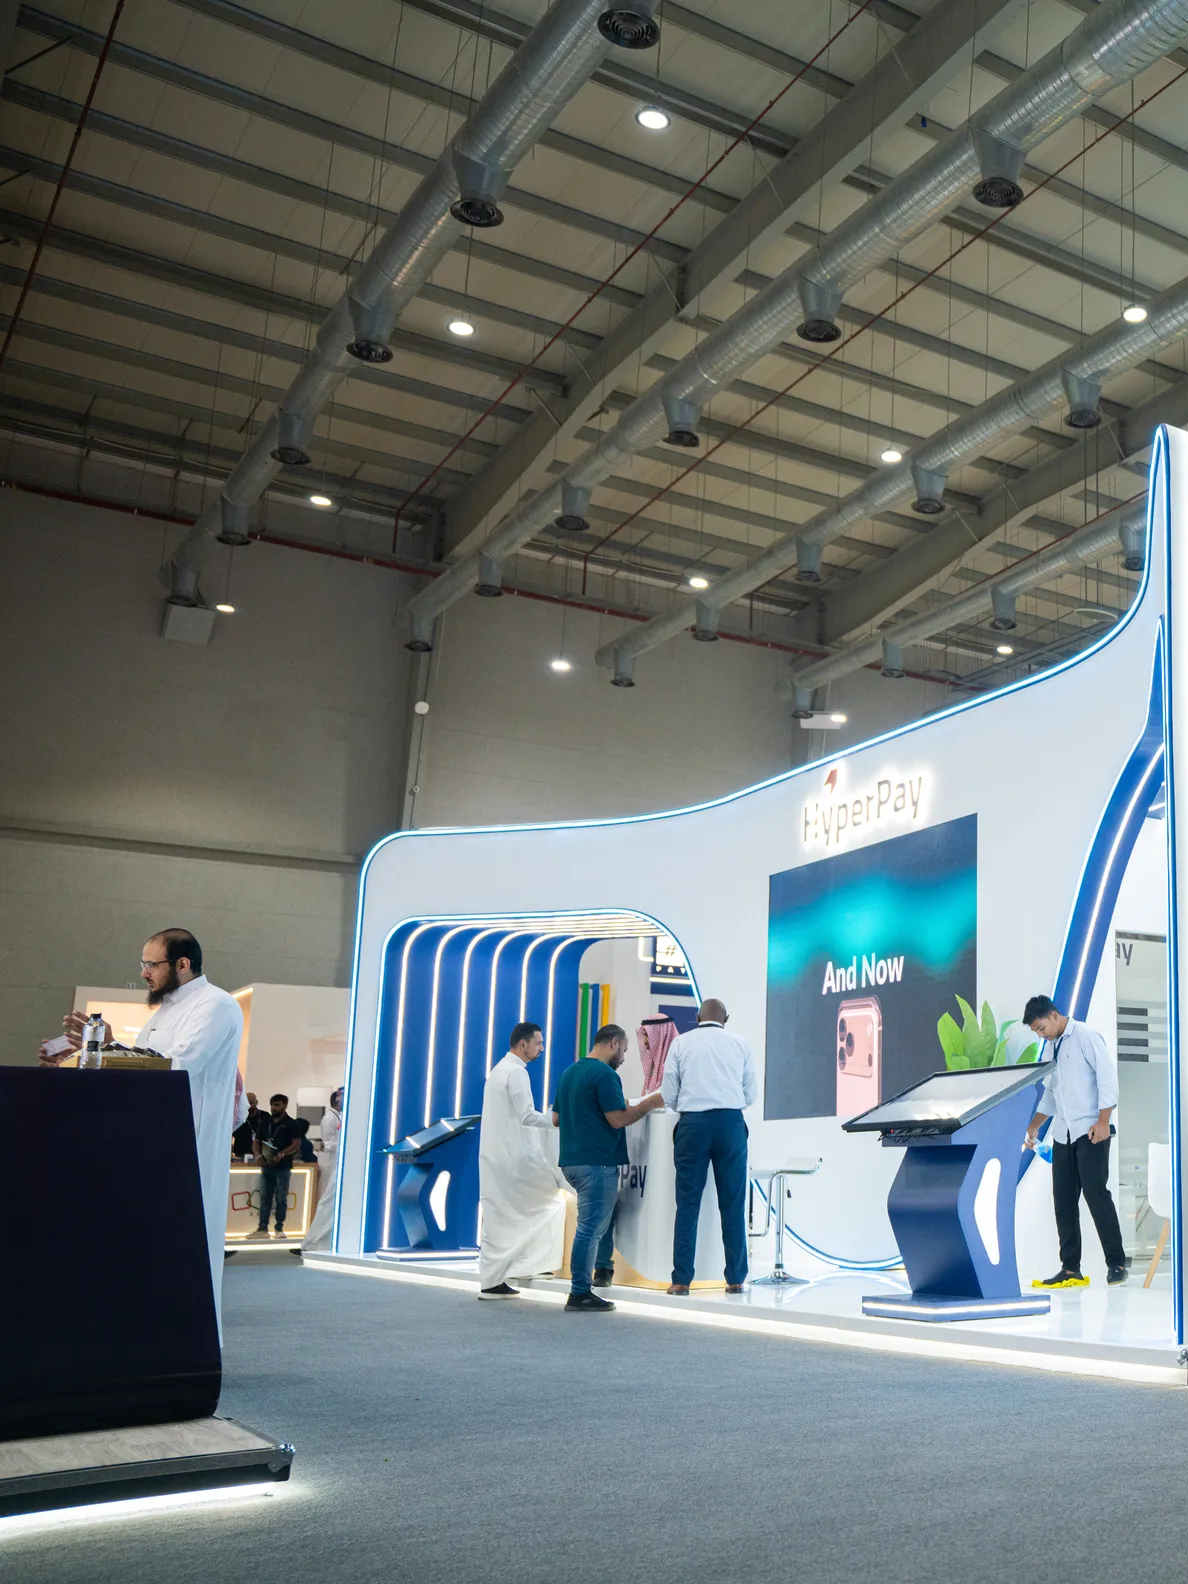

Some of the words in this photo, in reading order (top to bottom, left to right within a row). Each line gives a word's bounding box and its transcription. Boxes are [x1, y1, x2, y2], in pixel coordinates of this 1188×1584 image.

[803, 776, 923, 846] HyperPay
[822, 955, 857, 995] And
[861, 952, 905, 988] Now
[620, 1163, 648, 1199] Pay
